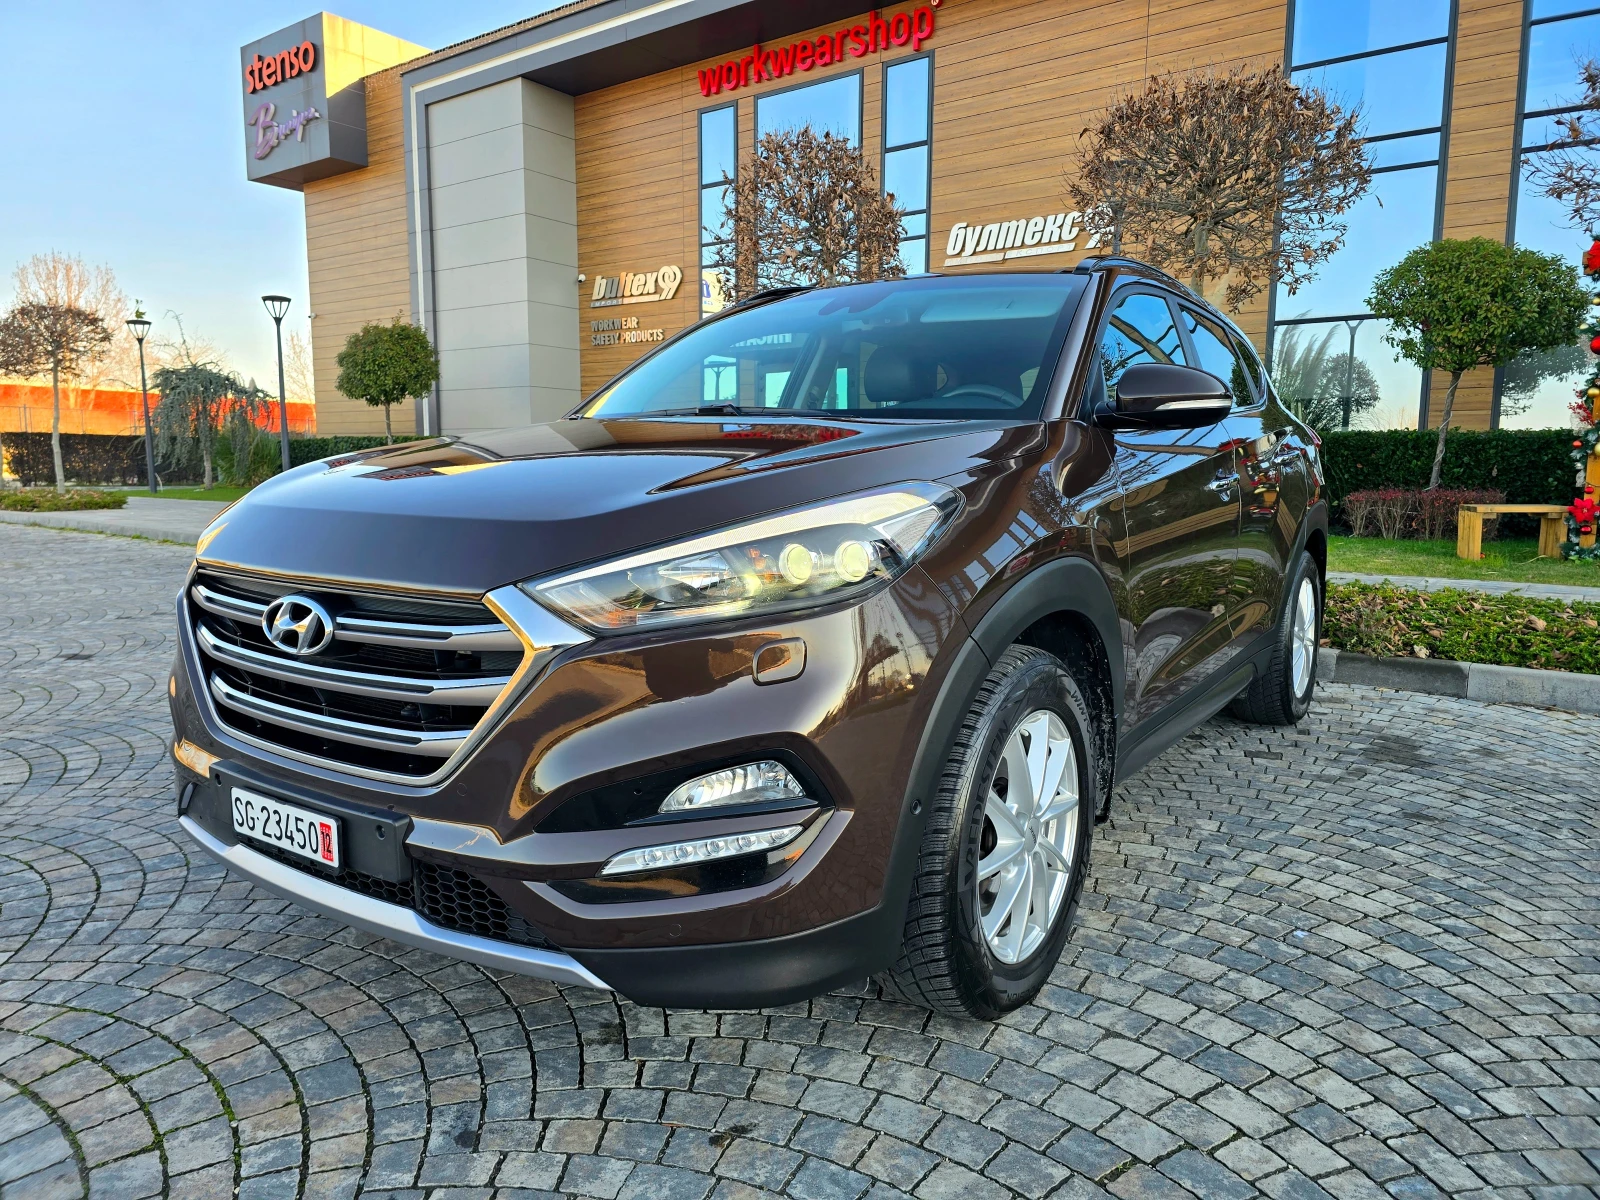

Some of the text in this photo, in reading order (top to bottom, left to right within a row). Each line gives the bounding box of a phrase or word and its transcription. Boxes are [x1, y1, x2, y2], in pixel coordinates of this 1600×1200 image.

[245, 40, 315, 94] stenso
[697, 6, 935, 97] workwearshop
[591, 316, 638, 332] WORKWEAR
[591, 329, 664, 346] SAFETY PRODUCTS
[964, 719, 1012, 887] VREDESTEIN
